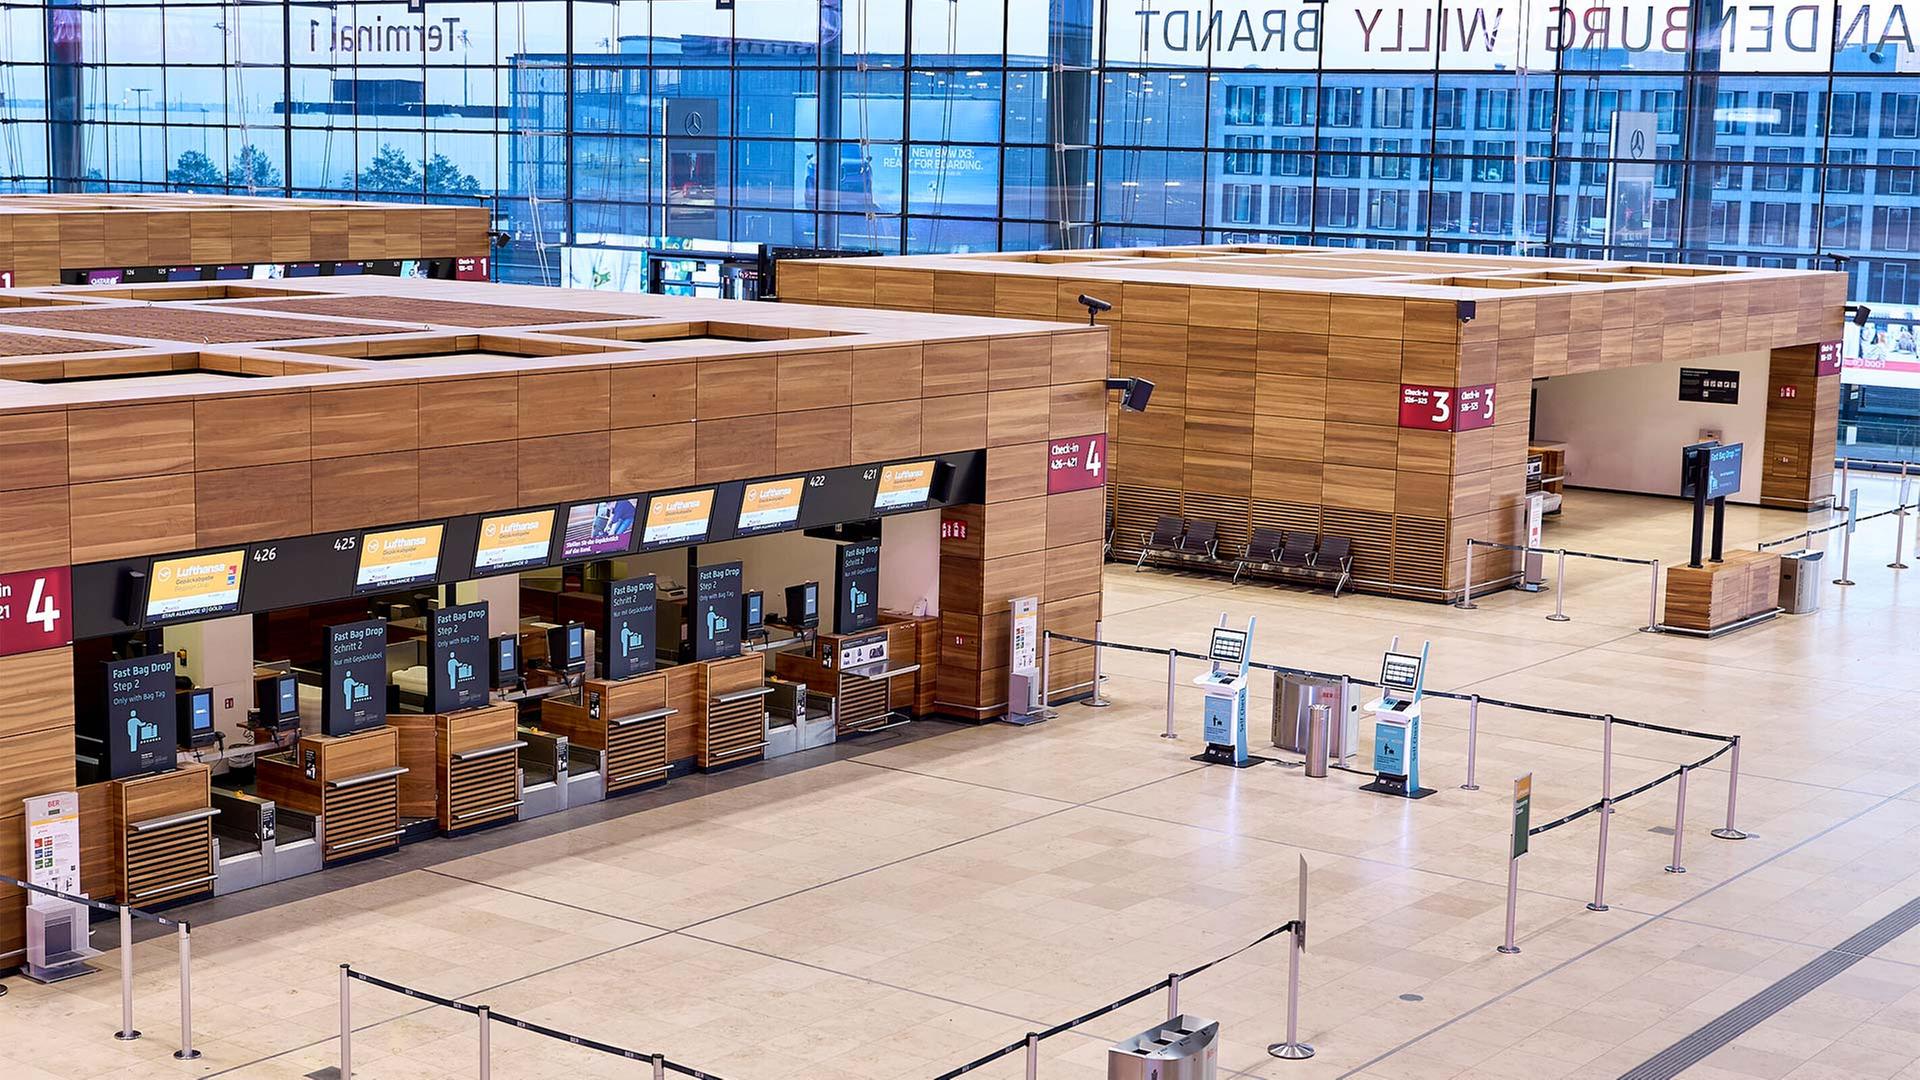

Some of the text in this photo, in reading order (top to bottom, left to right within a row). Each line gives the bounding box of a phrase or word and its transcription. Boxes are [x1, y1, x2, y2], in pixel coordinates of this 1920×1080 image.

[912, 148, 933, 158] NEW
[935, 148, 957, 158] BMW
[883, 158, 913, 168] REAY
[914, 160, 933, 169] FOR
[480, 258, 487, 276] 1
[1834, 343, 1842, 368] 3
[1404, 388, 1429, 397] Check-in
[1431, 391, 1450, 422] 3
[1483, 388, 1494, 419] 3
[1051, 442, 1079, 456] Check-in
[1085, 440, 1102, 477] 4
[809, 475, 825, 487] 422
[863, 469, 877, 480] 421
[760, 487, 792, 498] Lufthansa
[665, 500, 701, 511] Lufthansa
[500, 520, 540, 533] Lufthansa
[334, 536, 356, 551] 425
[384, 536, 427, 550] Lufthansa
[253, 547, 277, 562] 426
[845, 546, 878, 558] Fast Bag Drop
[860, 557, 864, 565] 2
[176, 562, 226, 578] Lufthansa
[700, 568, 740, 580] Fast Bag Drop
[613, 582, 654, 596] Fast Bag Drop
[700, 580, 717, 591] Step 2
[26, 577, 60, 633] 4
[613, 594, 637, 607] Schritt 2
[162, 611, 175, 619] STAR
[176, 608, 200, 617] ALLIANCE
[437, 609, 485, 624] Fast Bag Drop
[334, 627, 384, 642] Fast Bag Drop
[438, 624, 459, 636] Step 2
[334, 641, 363, 654] Schritt 2
[113, 662, 172, 679] Fast Bag Drop
[113, 679, 140, 693] Step 2
[113, 696, 128, 706] Only
[143, 692, 155, 702] Bag
[155, 690, 166, 700] Tag
[47, 799, 60, 808] BER
